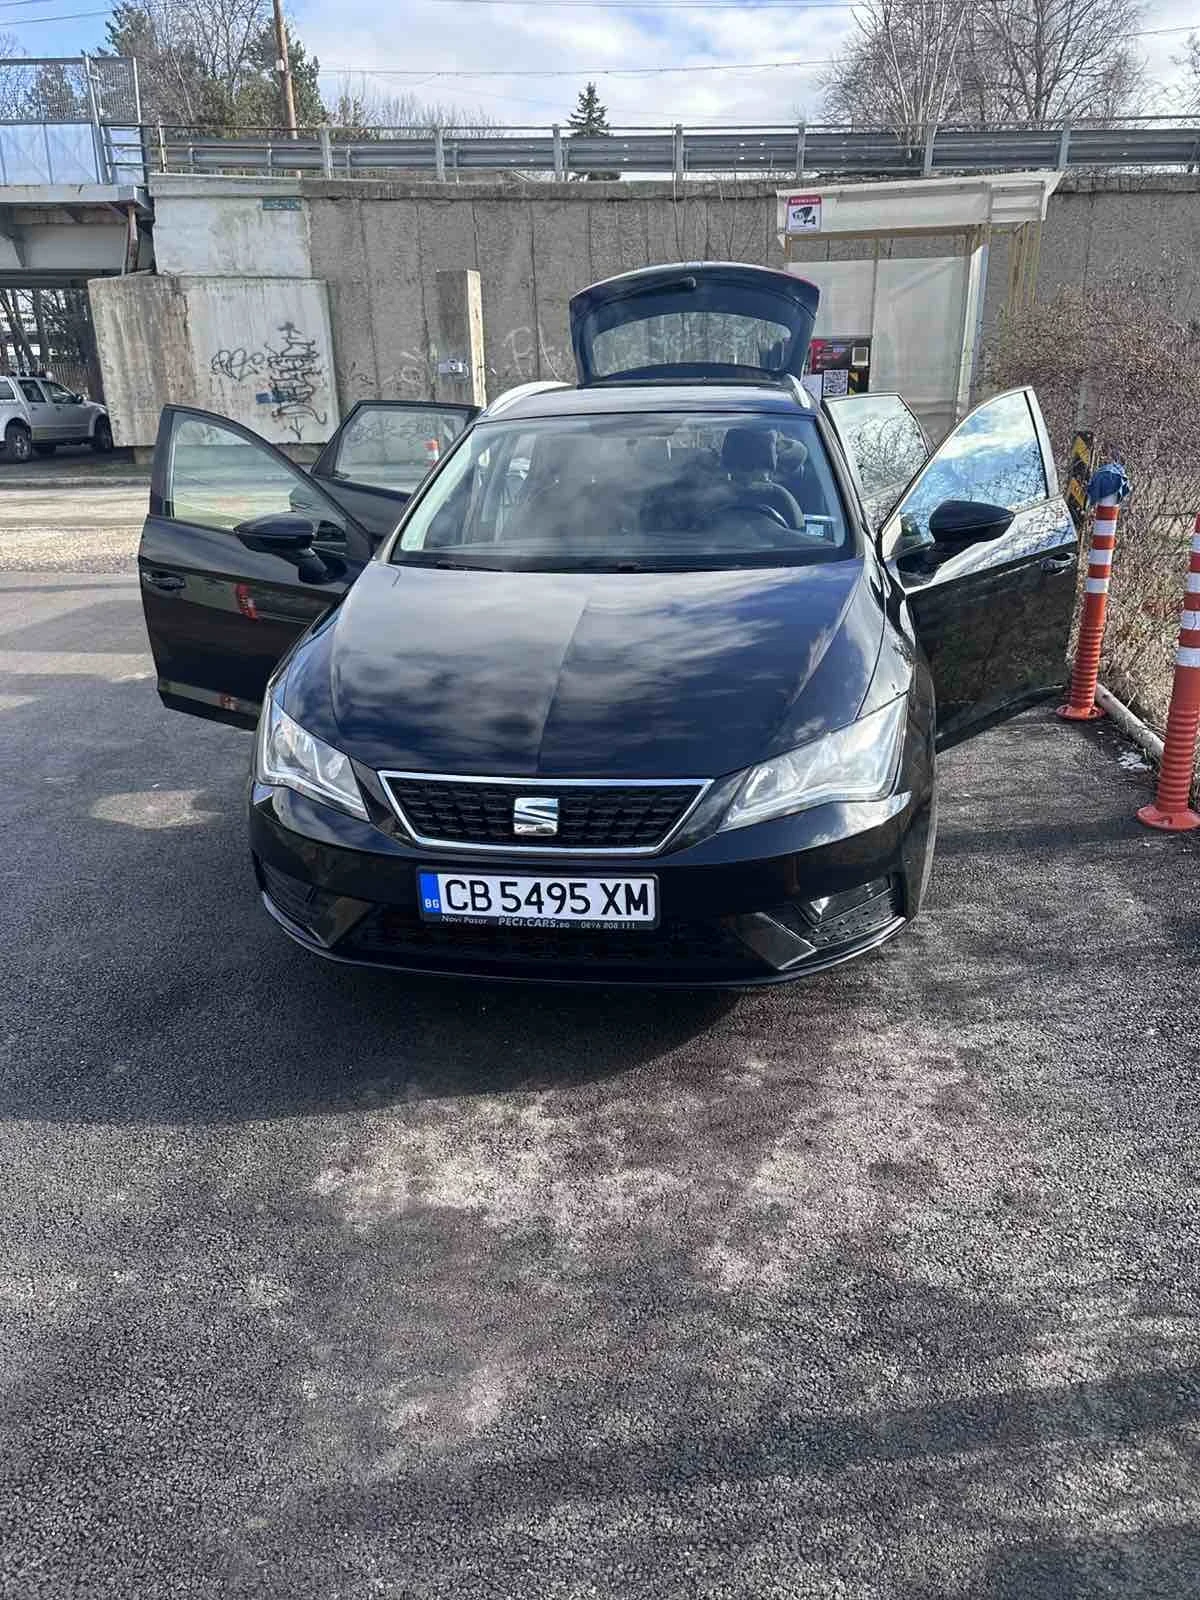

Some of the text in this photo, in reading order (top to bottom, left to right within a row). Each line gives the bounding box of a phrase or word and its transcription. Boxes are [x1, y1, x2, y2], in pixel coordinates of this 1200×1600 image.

[425, 899, 439, 909] BG
[445, 879, 649, 915] CB 5495 XM
